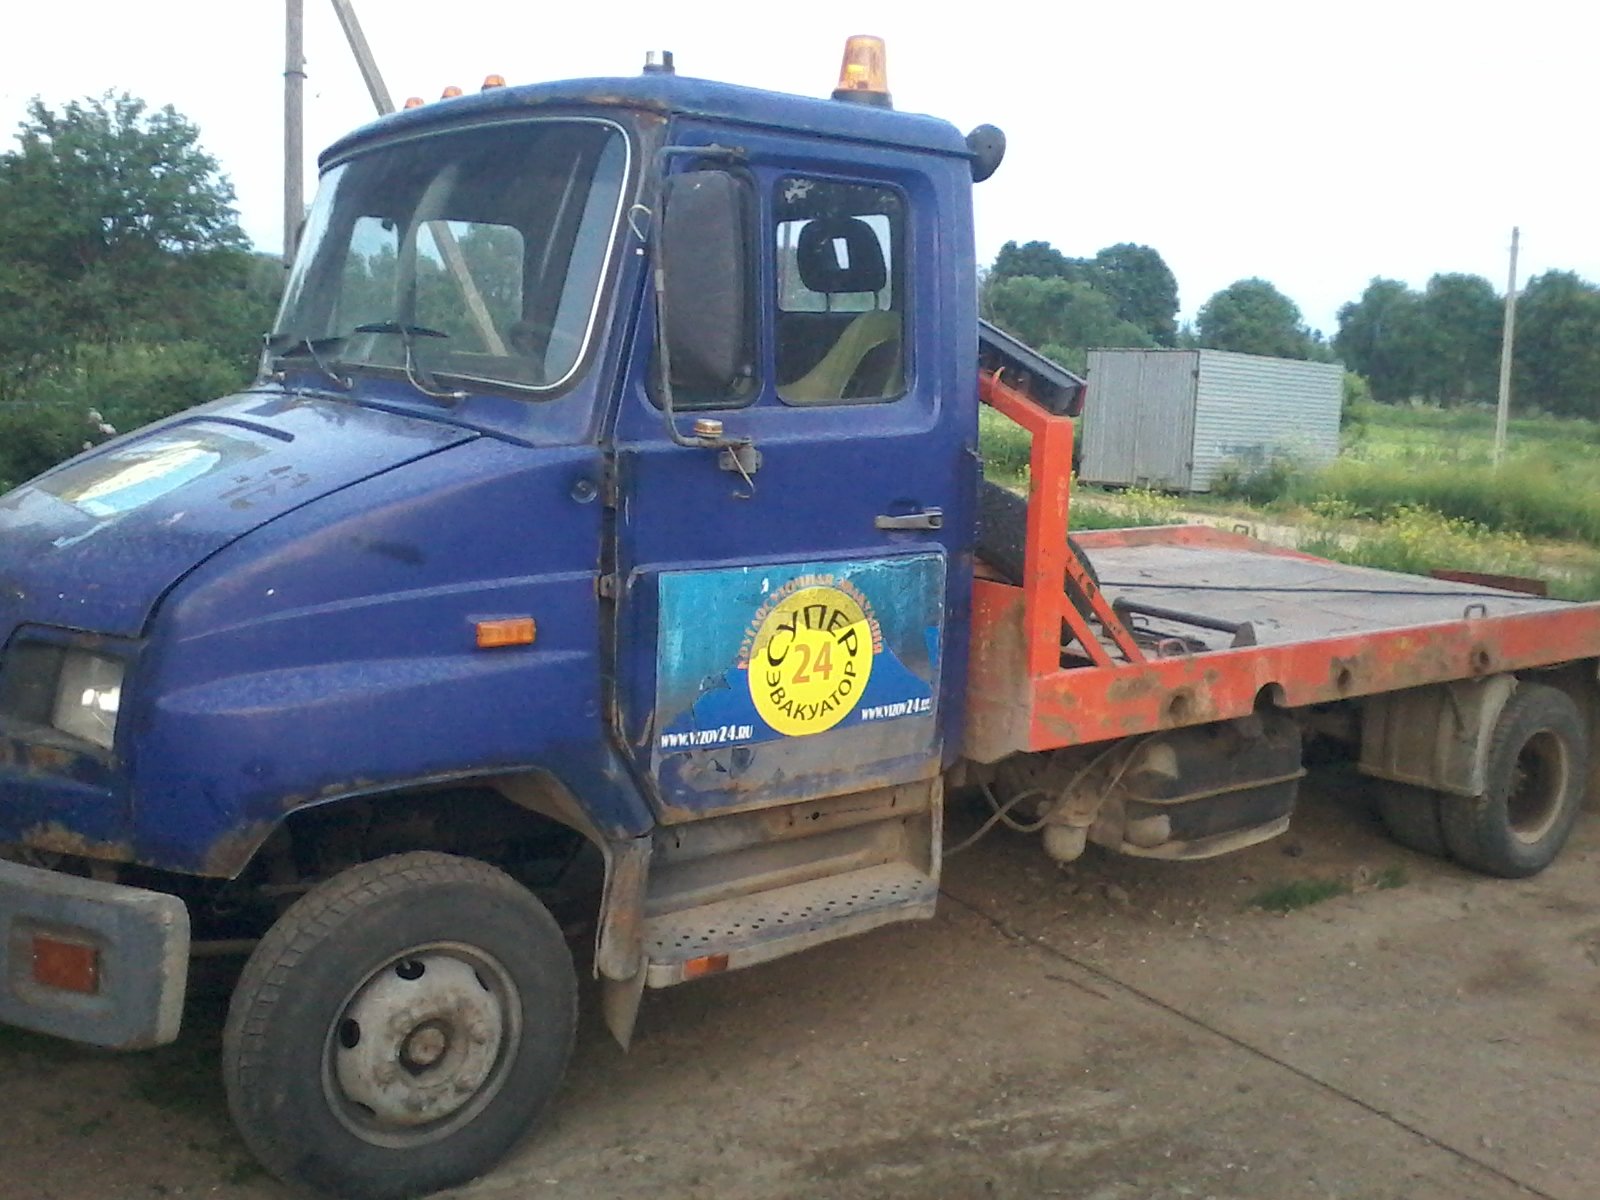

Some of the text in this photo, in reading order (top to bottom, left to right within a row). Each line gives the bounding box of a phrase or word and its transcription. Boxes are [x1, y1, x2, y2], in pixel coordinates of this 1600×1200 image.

[766, 604, 858, 667] СУПЕР
[791, 641, 834, 685] 24
[766, 660, 857, 721] ЭВАКУАТОР
